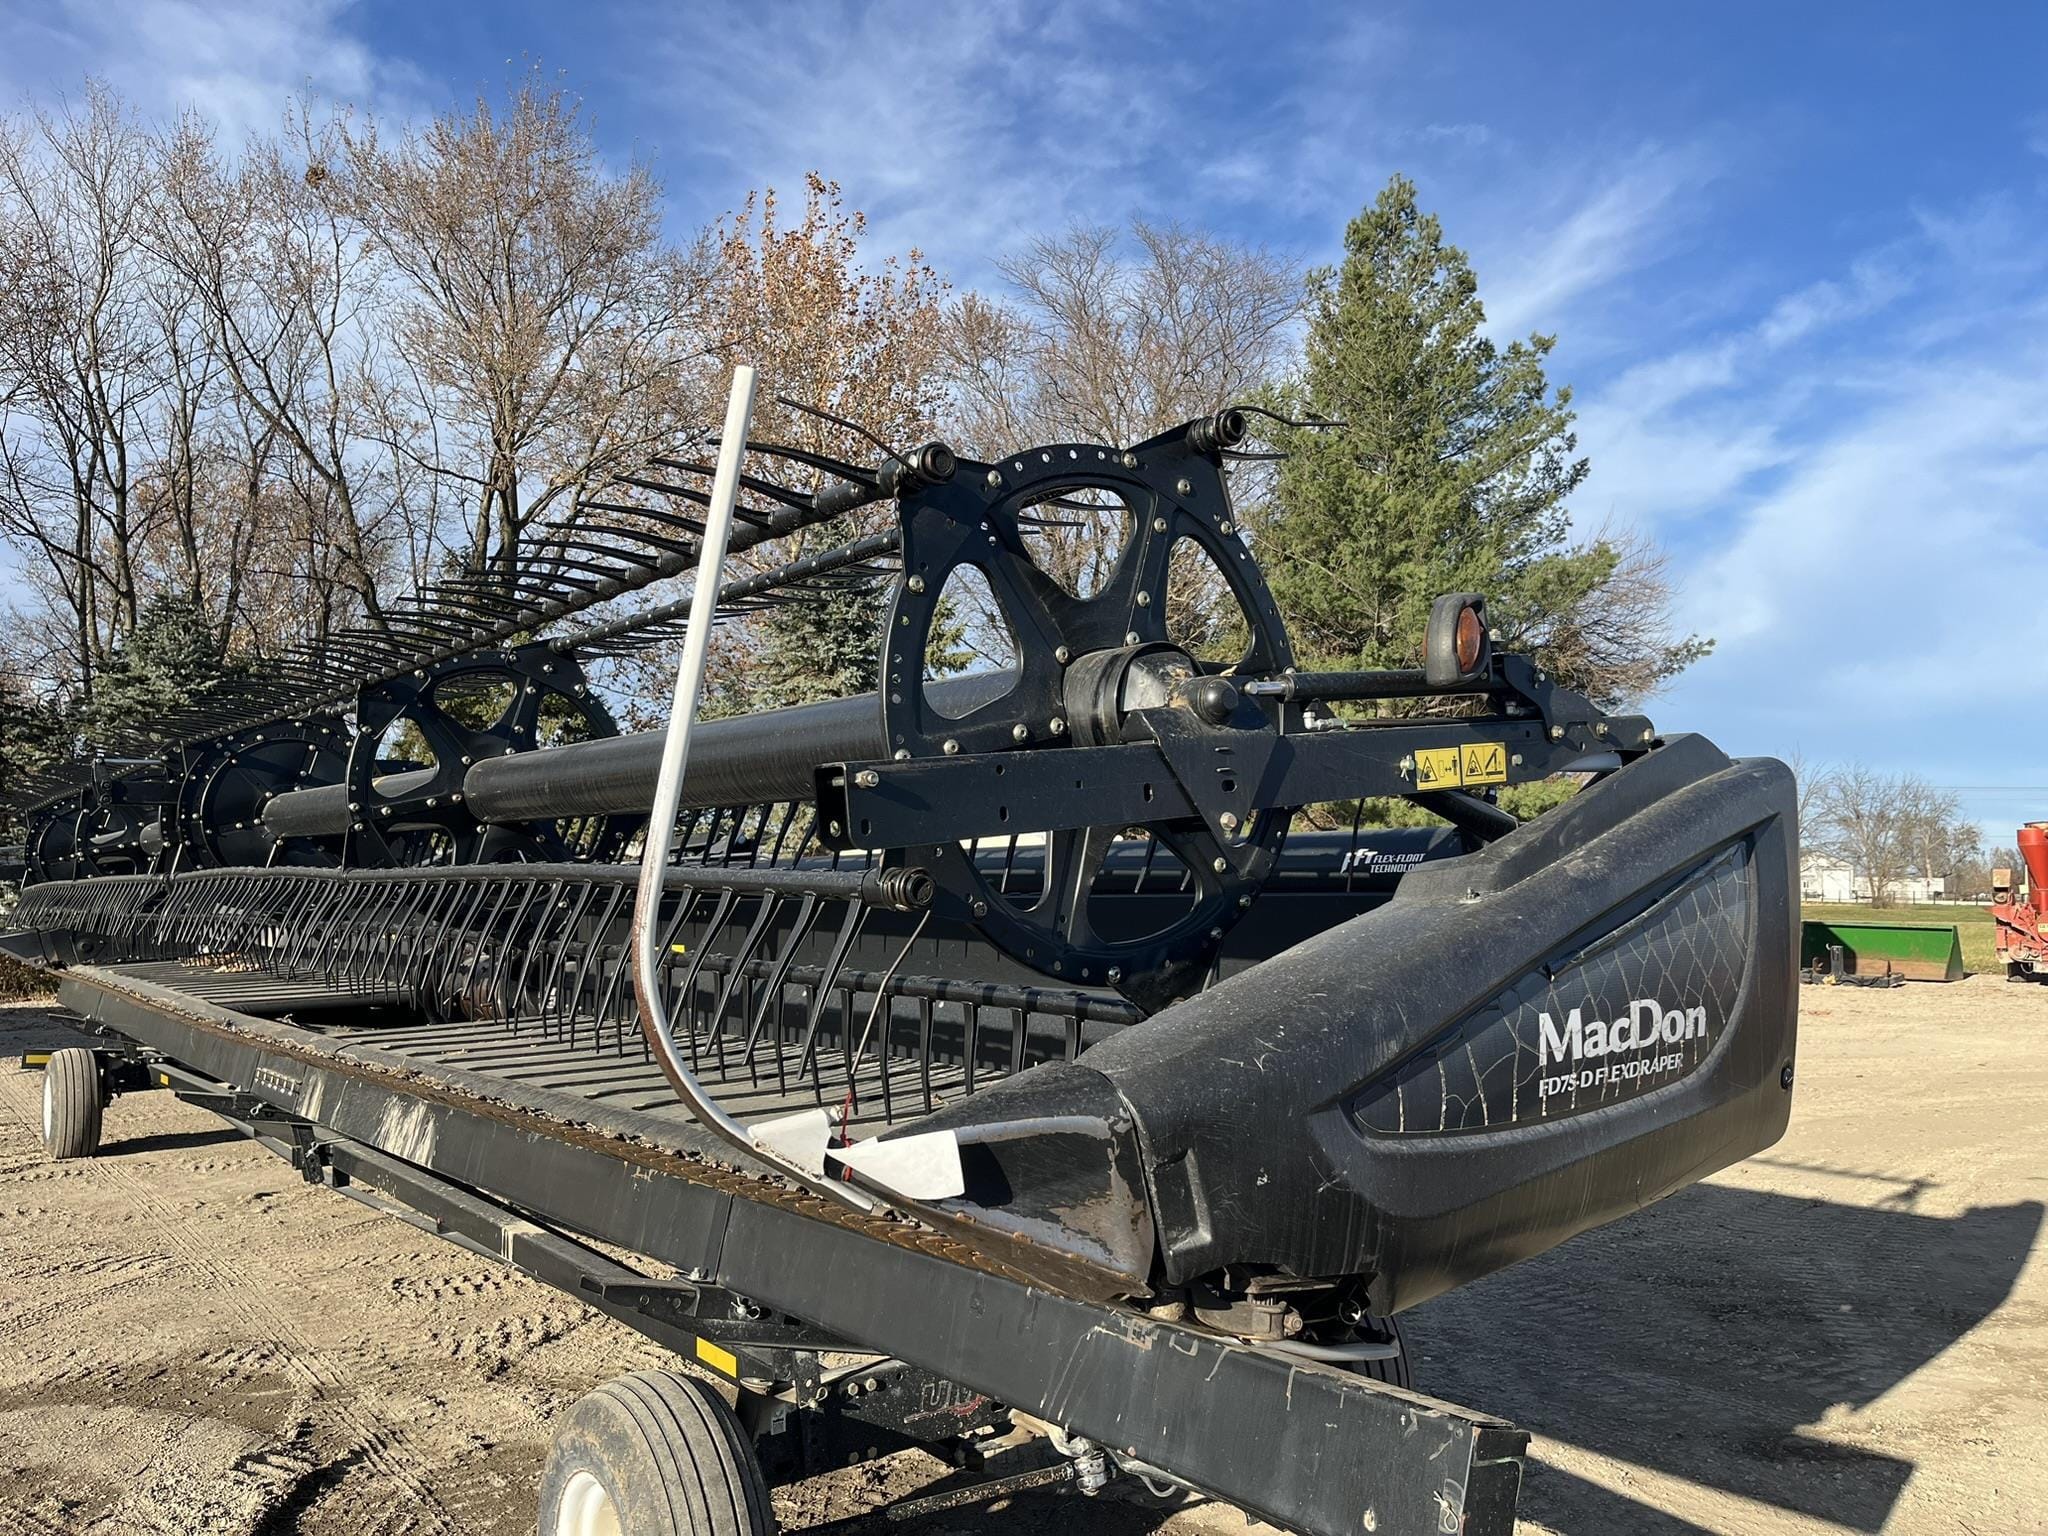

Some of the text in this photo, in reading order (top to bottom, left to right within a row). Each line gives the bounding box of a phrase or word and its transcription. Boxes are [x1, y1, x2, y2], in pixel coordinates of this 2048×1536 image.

[1370, 863, 1417, 874] TECHNOLO
[1373, 853, 1426, 864] FLEX-FLOAT
[1538, 998, 1707, 1066] MacDon
[1595, 1052, 1684, 1086] FLEXDRAPER
